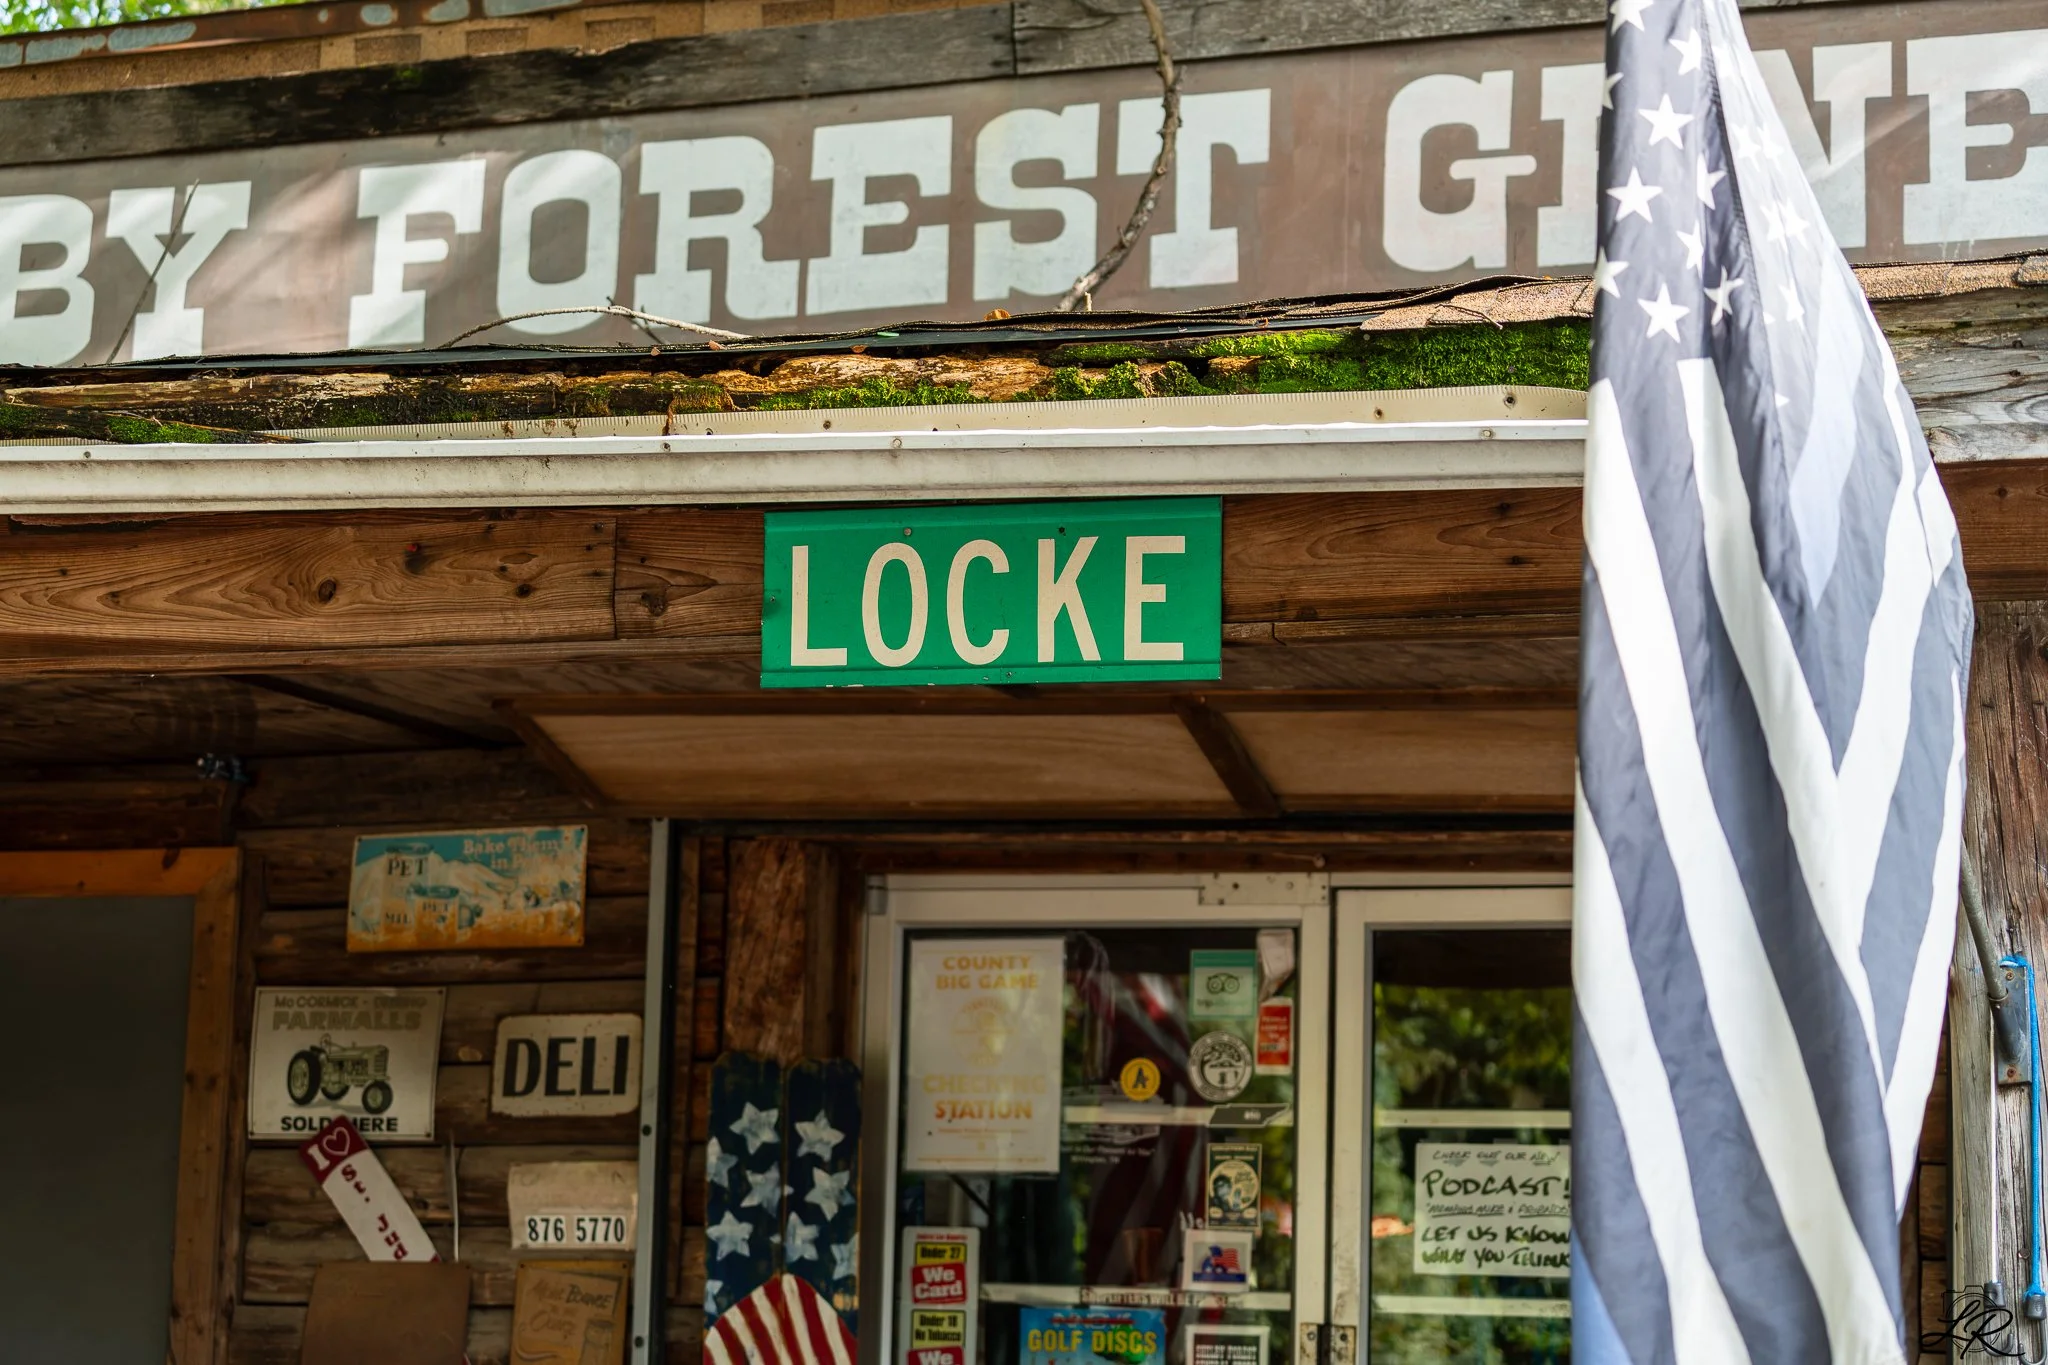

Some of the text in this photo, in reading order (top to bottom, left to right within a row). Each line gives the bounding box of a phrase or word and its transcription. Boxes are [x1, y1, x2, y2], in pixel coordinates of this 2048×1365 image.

[348, 88, 1271, 346] FOREST
[791, 535, 1186, 667] LOCKE
[463, 838, 505, 854] Bake
[387, 857, 428, 876] PET
[943, 955, 1031, 971] COUNTY
[936, 974, 1039, 990] BIG GAME
[273, 1010, 421, 1030] FARMALLS
[502, 1035, 630, 1098] DELI
[934, 1099, 1032, 1119] STATION
[281, 1116, 333, 1132] SOLD
[307, 1143, 330, 1171] I
[341, 1163, 370, 1203] St.
[1422, 1169, 1570, 1199] PODCAST!
[528, 1217, 624, 1242] 876 5770
[1421, 1224, 1570, 1244] LET US KNOW
[1474, 1246, 1505, 1269] YOU
[922, 1266, 955, 1282] We
[914, 1280, 962, 1299] Card
[1028, 1330, 1157, 1354] GOLF DISCS
[918, 1350, 953, 1365] We
